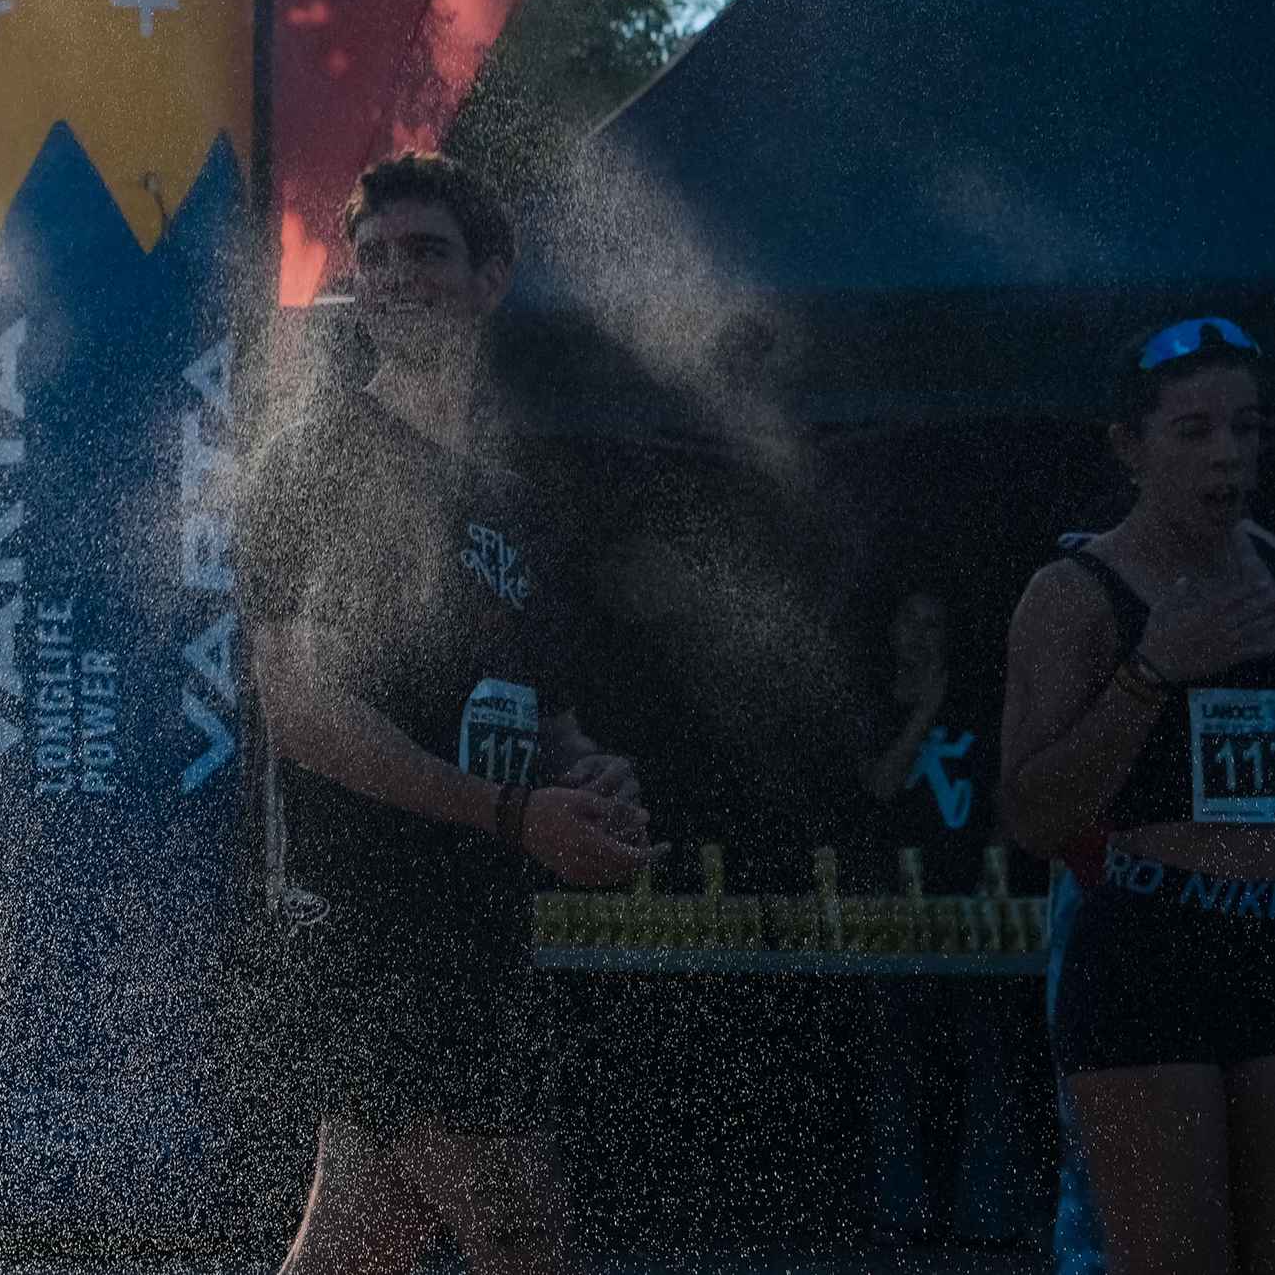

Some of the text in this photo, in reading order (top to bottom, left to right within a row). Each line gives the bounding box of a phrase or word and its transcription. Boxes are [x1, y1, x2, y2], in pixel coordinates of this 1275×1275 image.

[180, 334, 237, 795] VARTA
[36, 598, 75, 796] LONGLIFE
[79, 649, 117, 794] POWER
[478, 731, 534, 787] 117
[1214, 738, 1275, 792] 11
